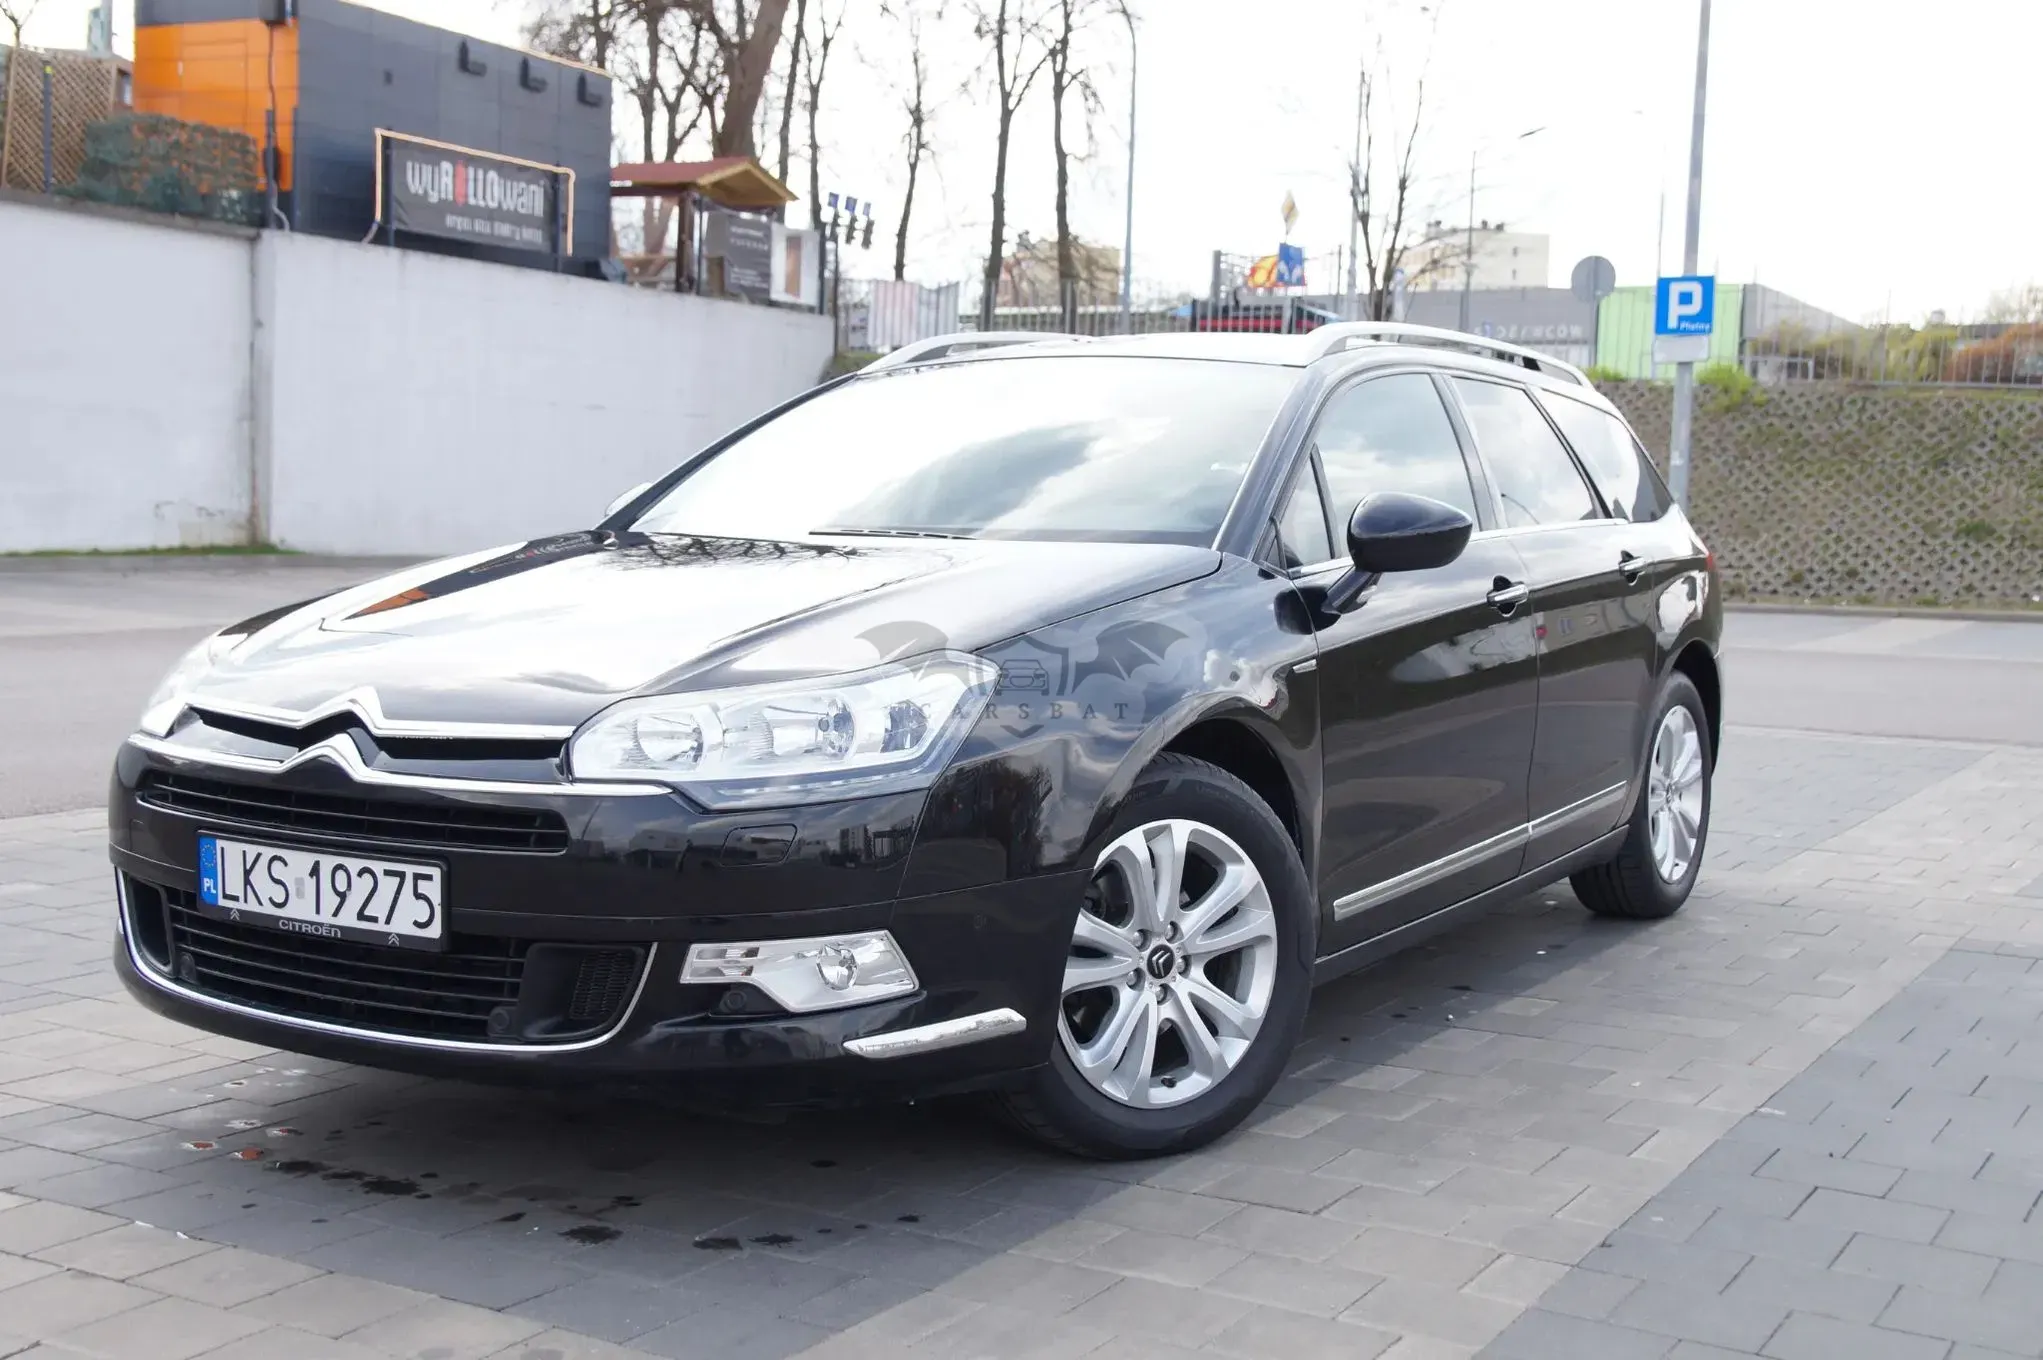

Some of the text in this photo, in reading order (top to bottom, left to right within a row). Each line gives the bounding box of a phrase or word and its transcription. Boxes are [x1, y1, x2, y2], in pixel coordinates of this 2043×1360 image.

[1667, 281, 1703, 329] P
[203, 877, 216, 894] PL
[220, 846, 436, 930] LKS 19275
